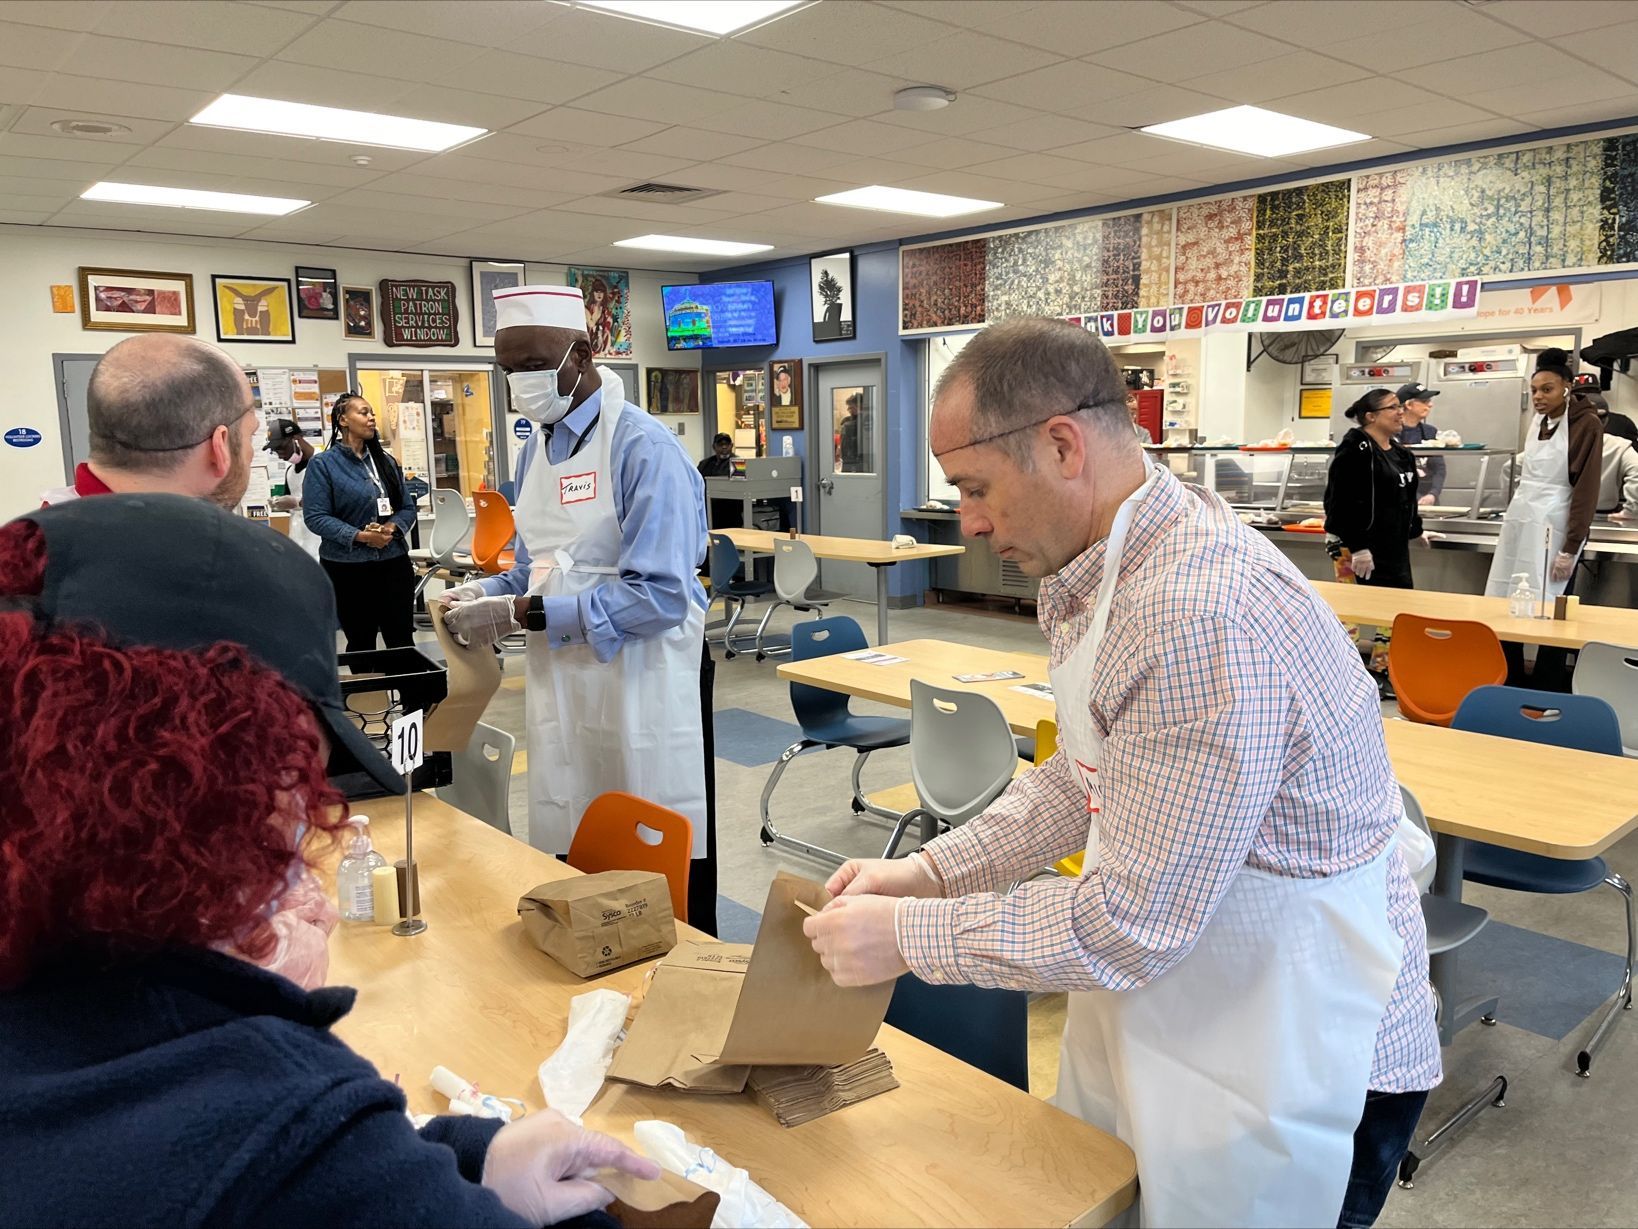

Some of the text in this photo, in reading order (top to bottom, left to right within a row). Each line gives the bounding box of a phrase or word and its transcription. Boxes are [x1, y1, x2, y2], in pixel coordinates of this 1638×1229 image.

[392, 286, 448, 299] NEW TASK
[401, 300, 442, 313] PATRON
[1136, 314, 1182, 328] You
[1208, 284, 1470, 320] Volunteers!!
[1499, 308, 1511, 316] for
[1513, 307, 1525, 315] 40
[1527, 306, 1554, 314] Years
[395, 314, 450, 327] SERVICES
[402, 328, 447, 340] WINDOW
[397, 721, 418, 765] 10
[601, 910, 621, 921] Sysco
